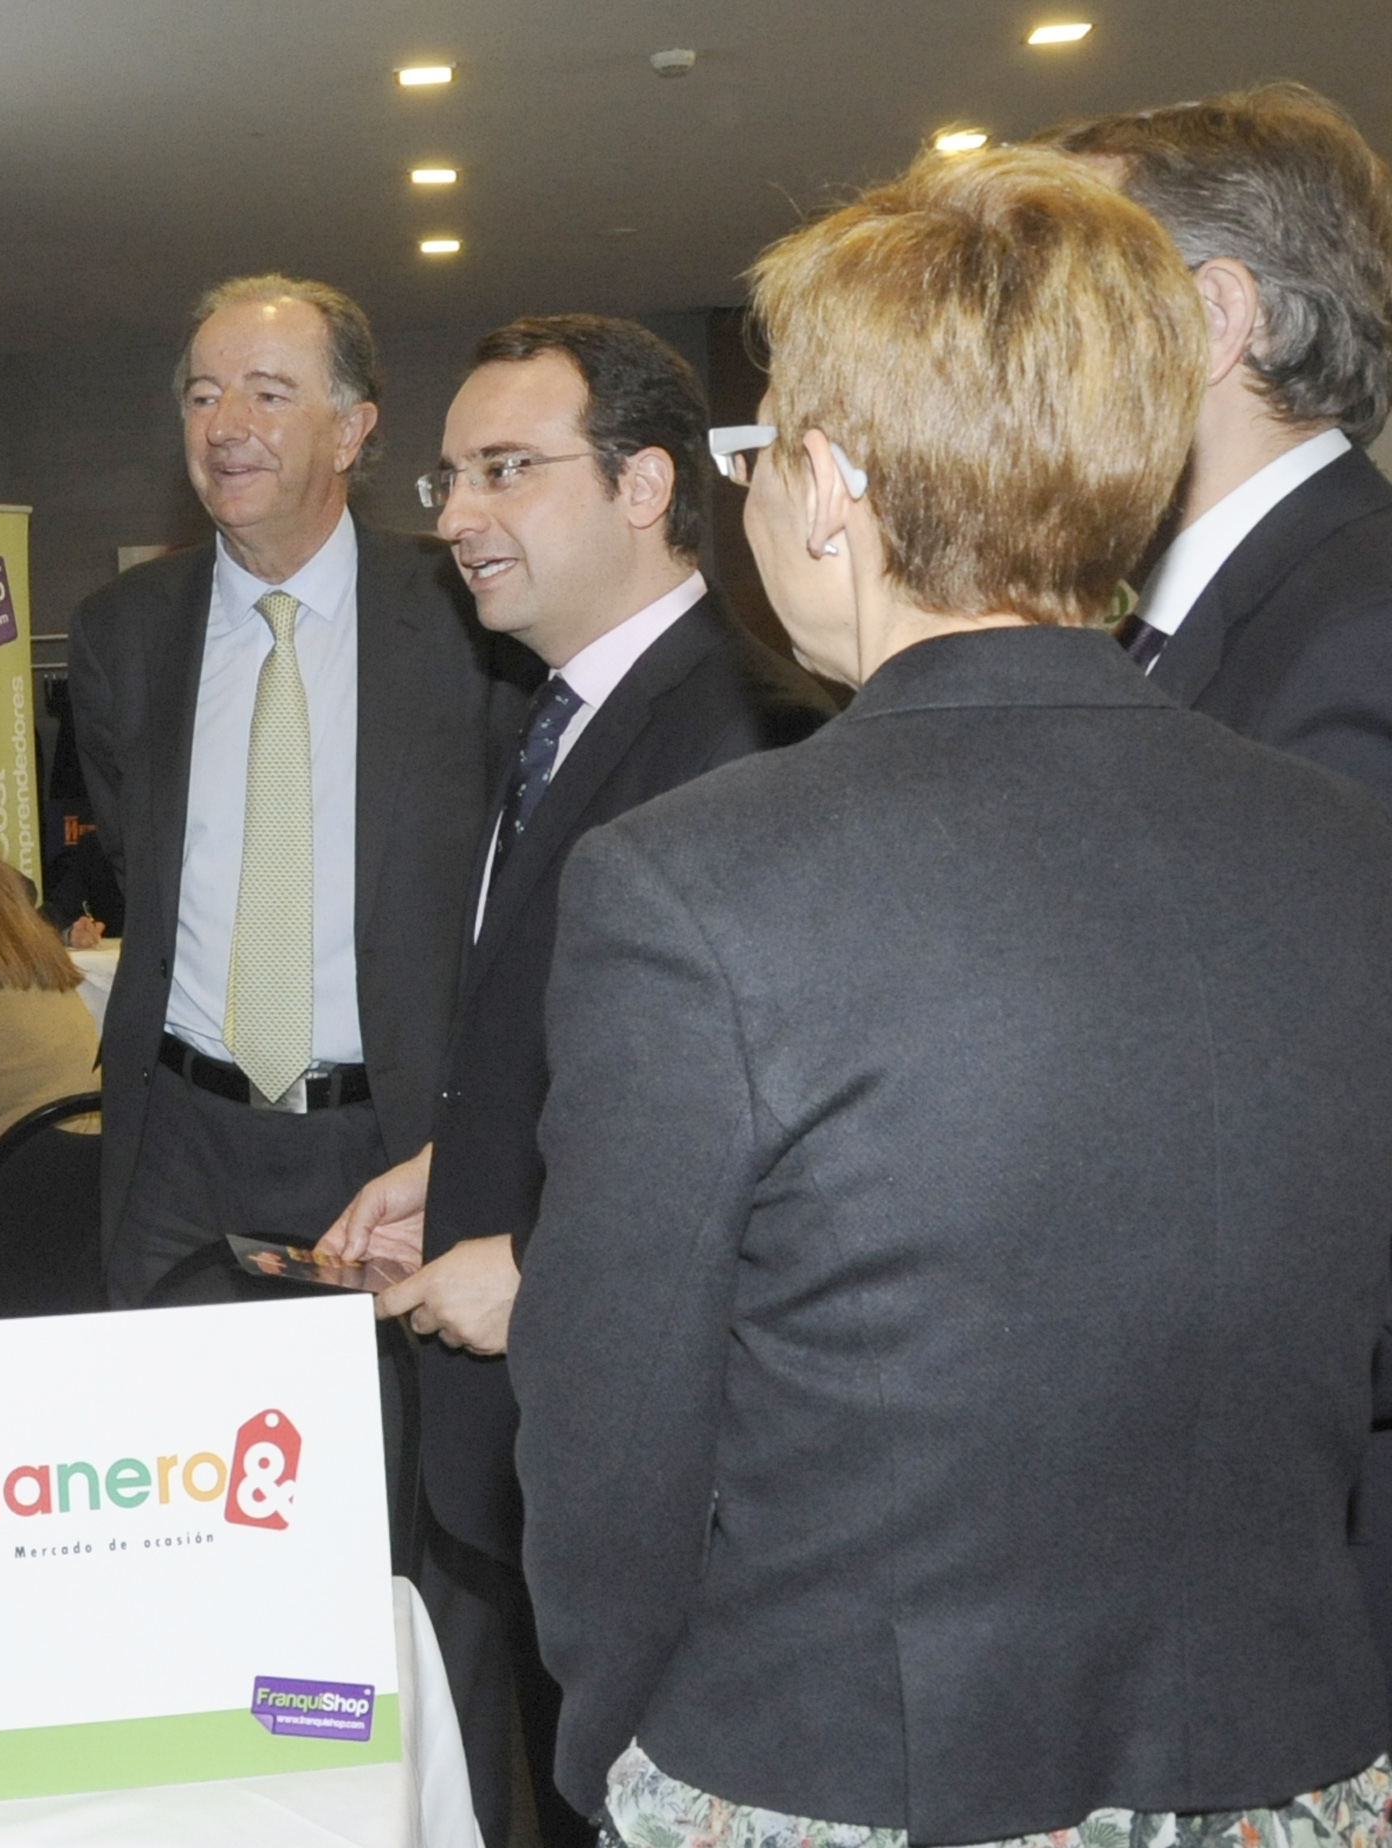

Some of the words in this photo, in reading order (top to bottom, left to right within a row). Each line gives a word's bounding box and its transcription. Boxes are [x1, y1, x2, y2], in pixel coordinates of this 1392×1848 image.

[12, 675, 35, 878] mprendedores
[14, 1541, 93, 1559] Mercado
[108, 1538, 127, 1551] de
[143, 1532, 214, 1548] ocasión
[256, 1688, 369, 1718] FranquiShop
